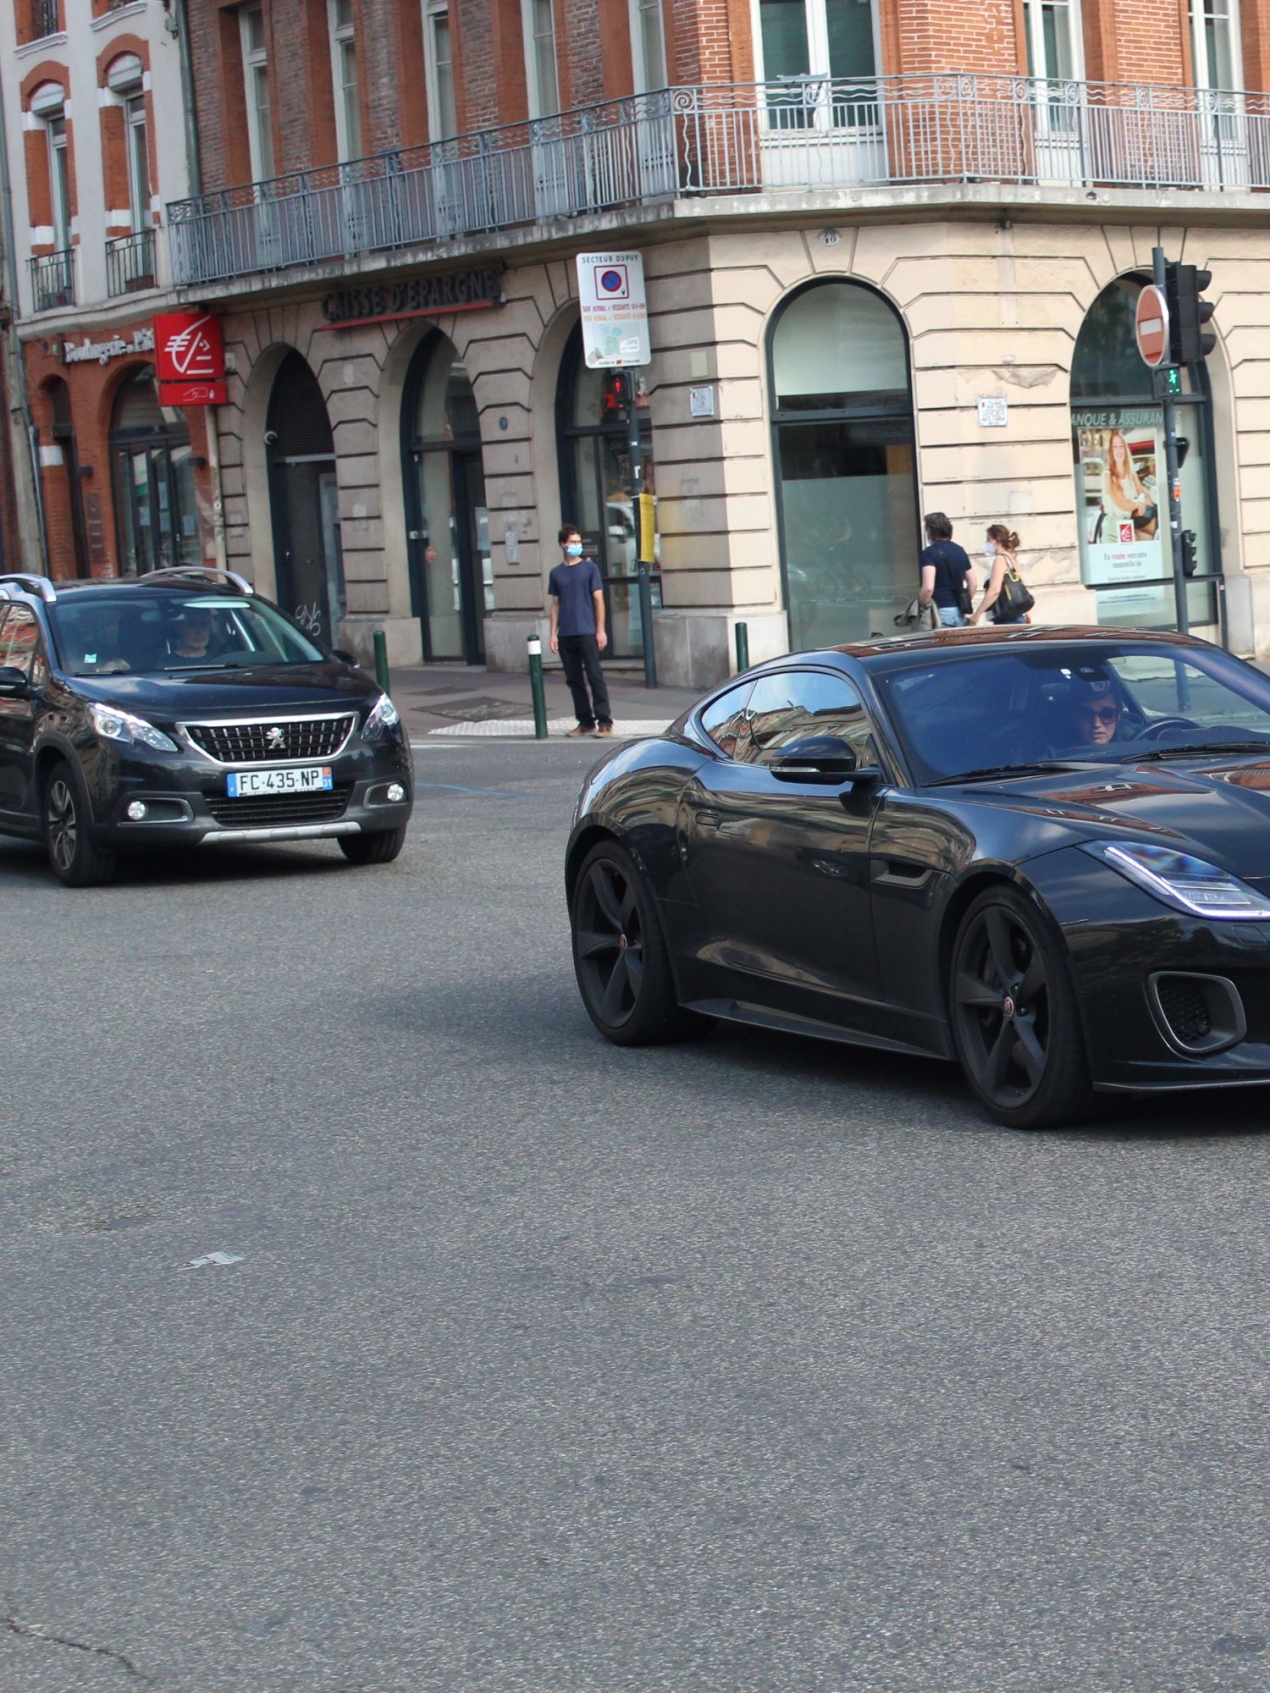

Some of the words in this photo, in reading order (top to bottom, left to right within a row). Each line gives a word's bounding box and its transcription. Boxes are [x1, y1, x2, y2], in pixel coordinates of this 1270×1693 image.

[582, 256, 613, 264] SECTEUR
[321, 286, 383, 322] CAISSE
[1109, 413, 1118, 426] &
[240, 770, 320, 791] FC-435-NP
